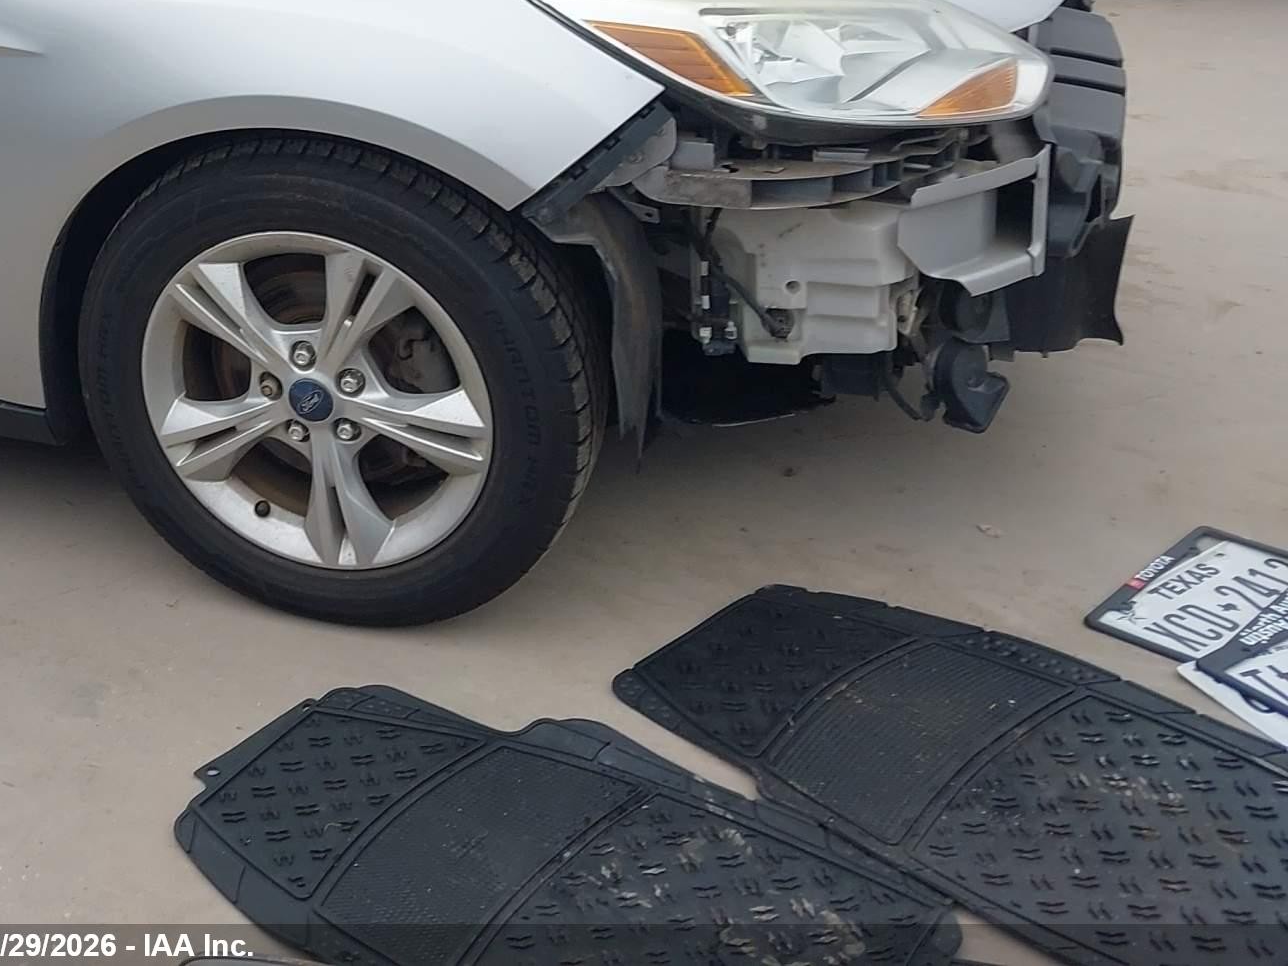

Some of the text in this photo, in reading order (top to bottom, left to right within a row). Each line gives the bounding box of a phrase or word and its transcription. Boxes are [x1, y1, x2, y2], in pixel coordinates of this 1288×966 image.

[1133, 554, 1176, 582] TOYOTA
[1147, 562, 1221, 600] TEXAS
[1143, 604, 1240, 653] XCD
